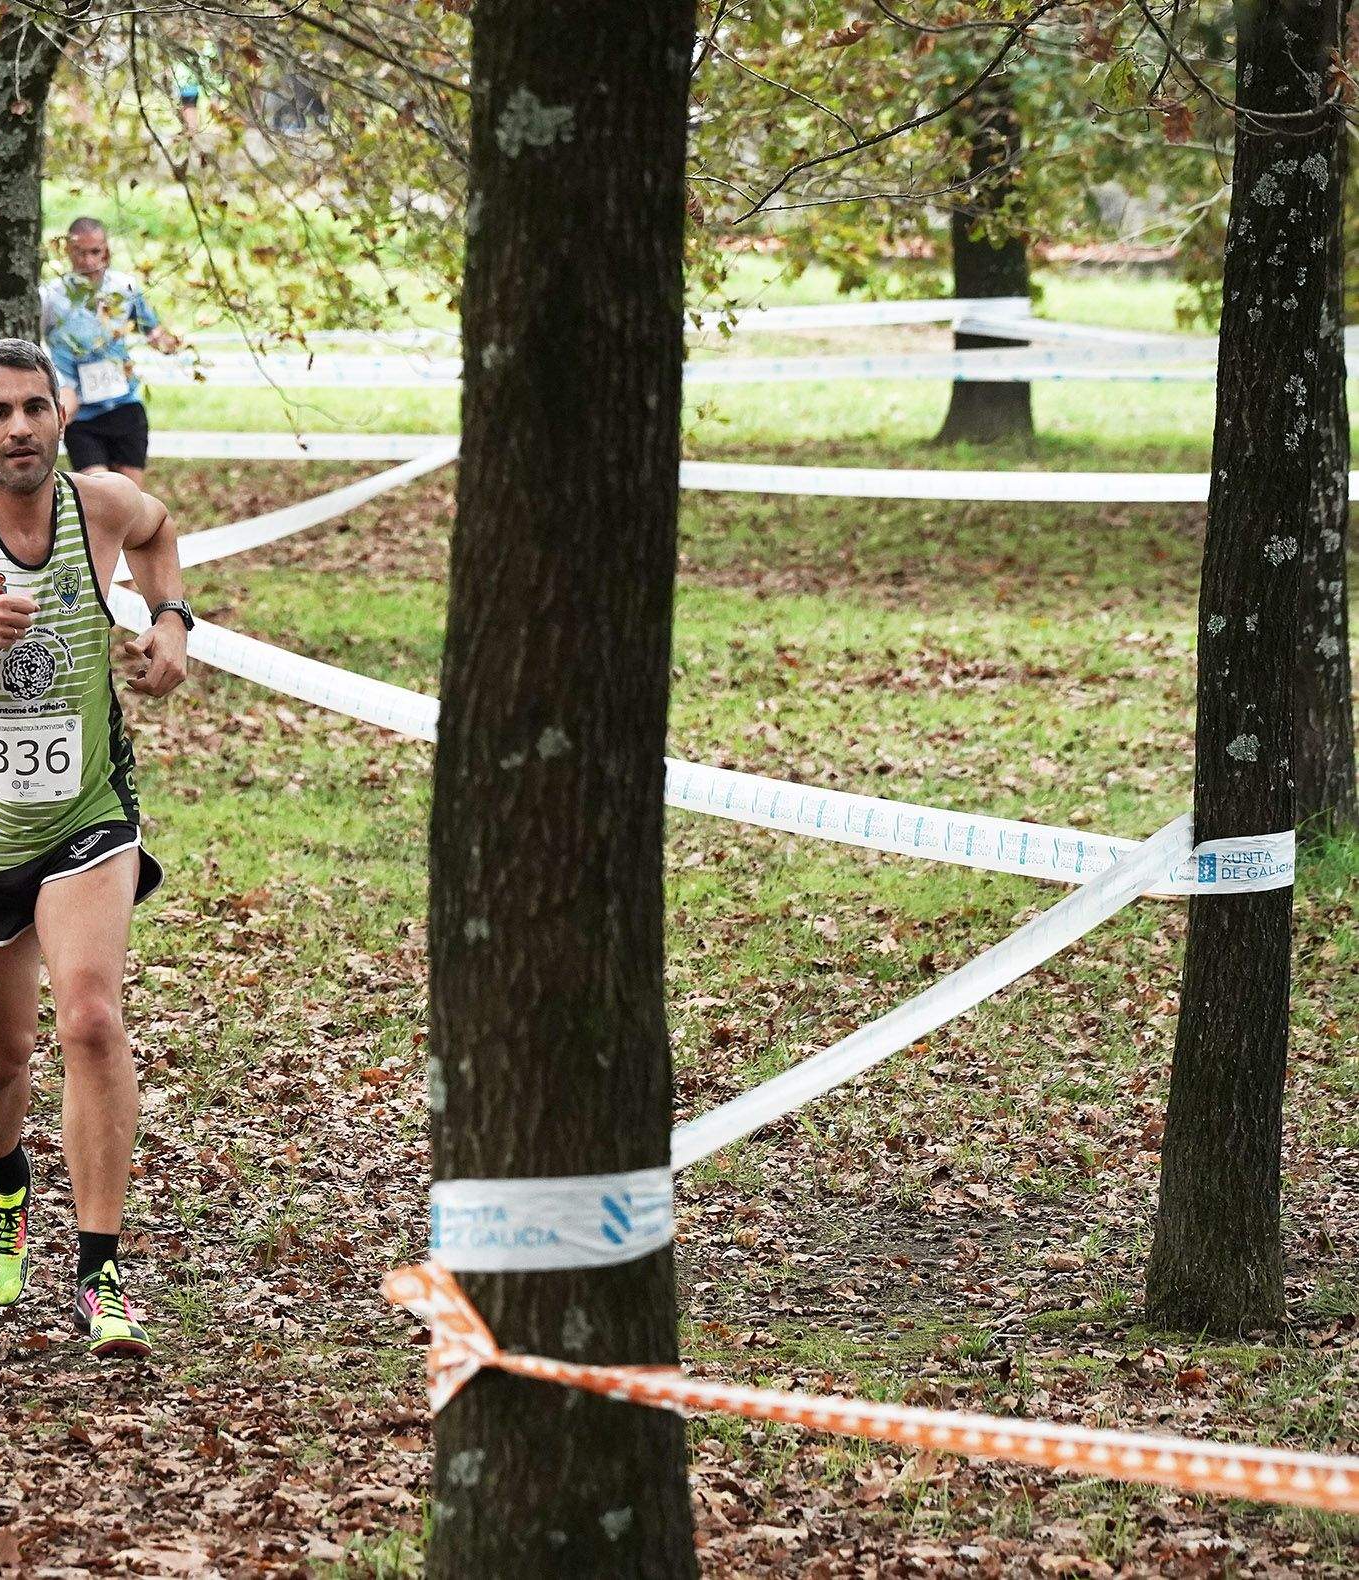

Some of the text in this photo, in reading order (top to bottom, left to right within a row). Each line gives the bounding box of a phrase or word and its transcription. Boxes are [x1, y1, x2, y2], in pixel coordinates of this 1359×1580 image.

[28, 705, 39, 713] de
[39, 702, 67, 711] Piñeiro
[1222, 851, 1274, 864] XUNTA
[1222, 867, 1240, 879] DE
